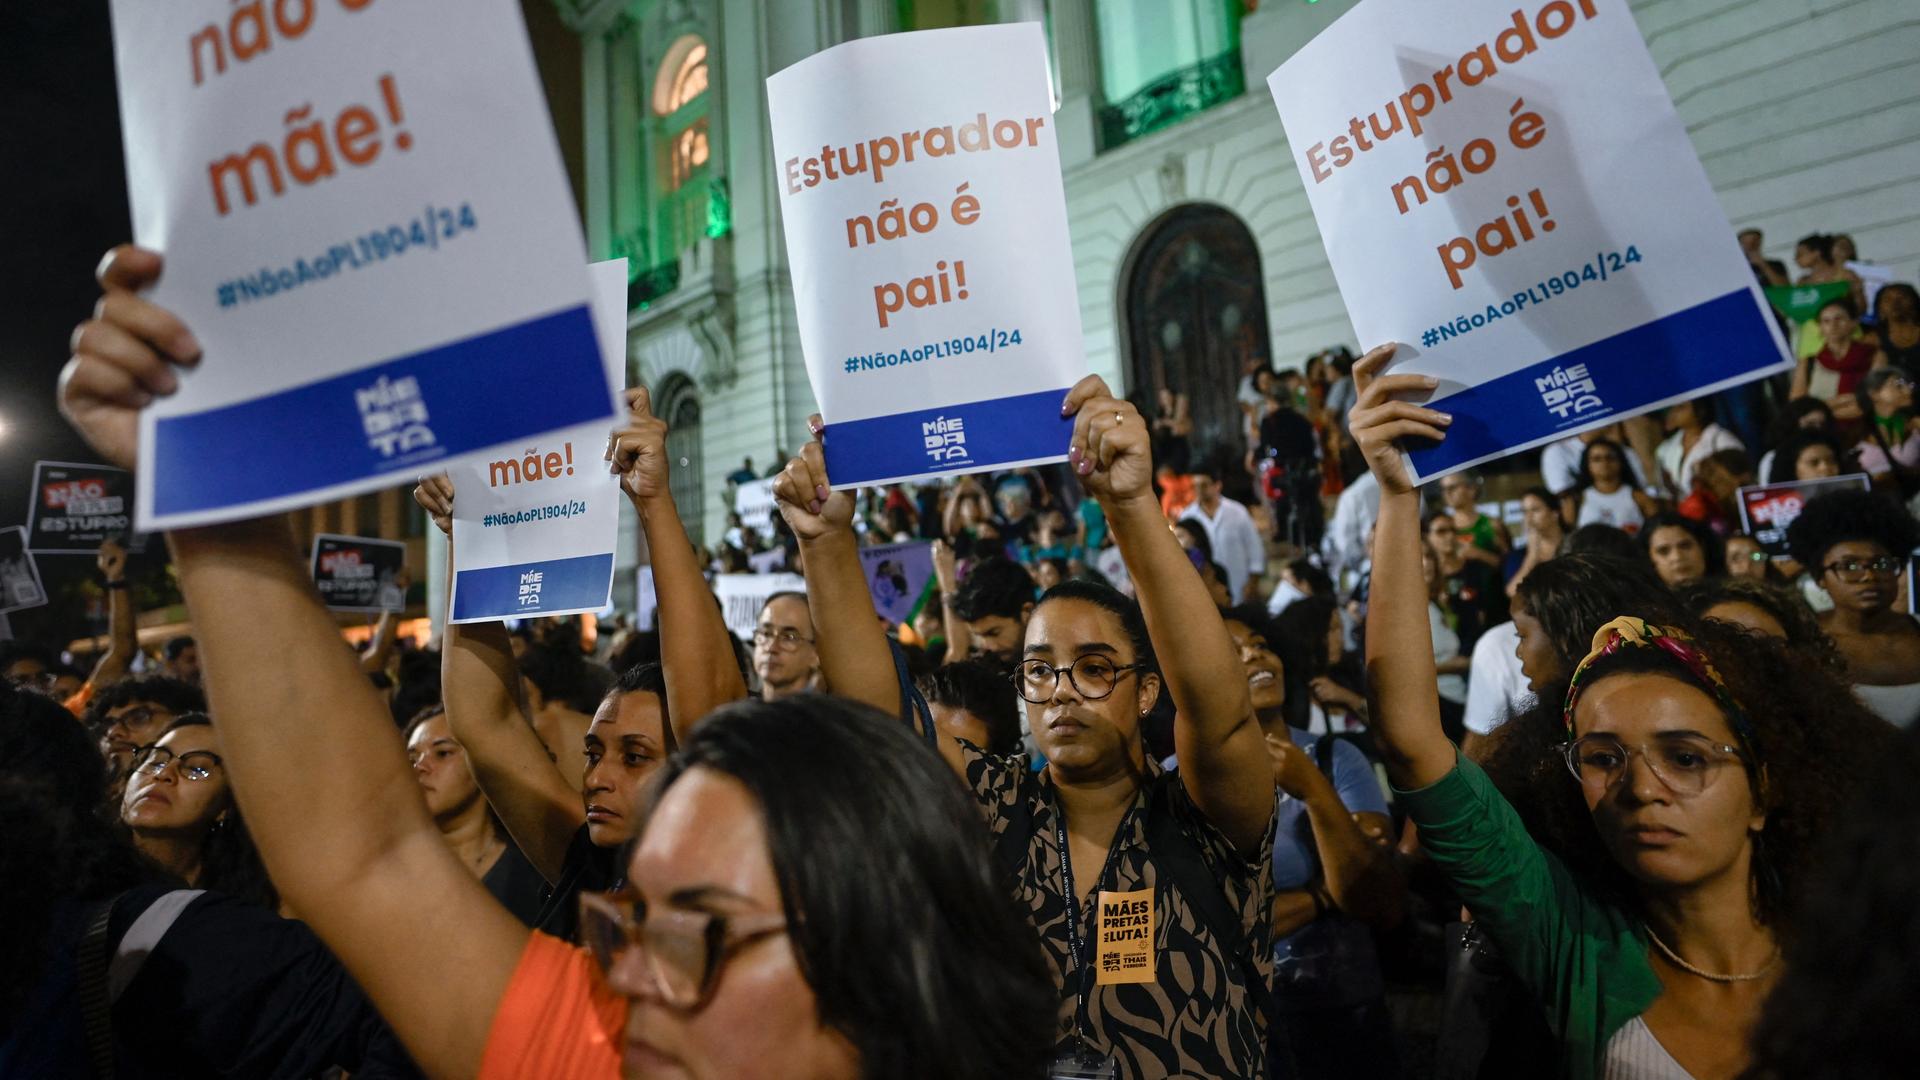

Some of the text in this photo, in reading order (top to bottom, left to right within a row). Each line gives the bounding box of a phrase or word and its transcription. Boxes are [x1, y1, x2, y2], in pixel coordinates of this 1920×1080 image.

[209, 71, 413, 217] mãe!
[785, 113, 1044, 195] Estuprador
[1391, 97, 1546, 215] não é
[846, 181, 981, 248] não é
[1436, 188, 1556, 290] pai!
[216, 202, 477, 308] #NãoAoPL1904/24
[874, 260, 969, 328] pai!
[1421, 245, 1643, 348] #NãoAoPL1904/24
[845, 328, 1023, 373] #NãoAoPL1904/24
[489, 442, 574, 487] mãe!
[483, 499, 586, 528] #NãoAoPL1904/24
[1103, 900, 1149, 917] MÃES
[1103, 914, 1149, 928] PRETAS
[1110, 926, 1149, 942] LUTA!
